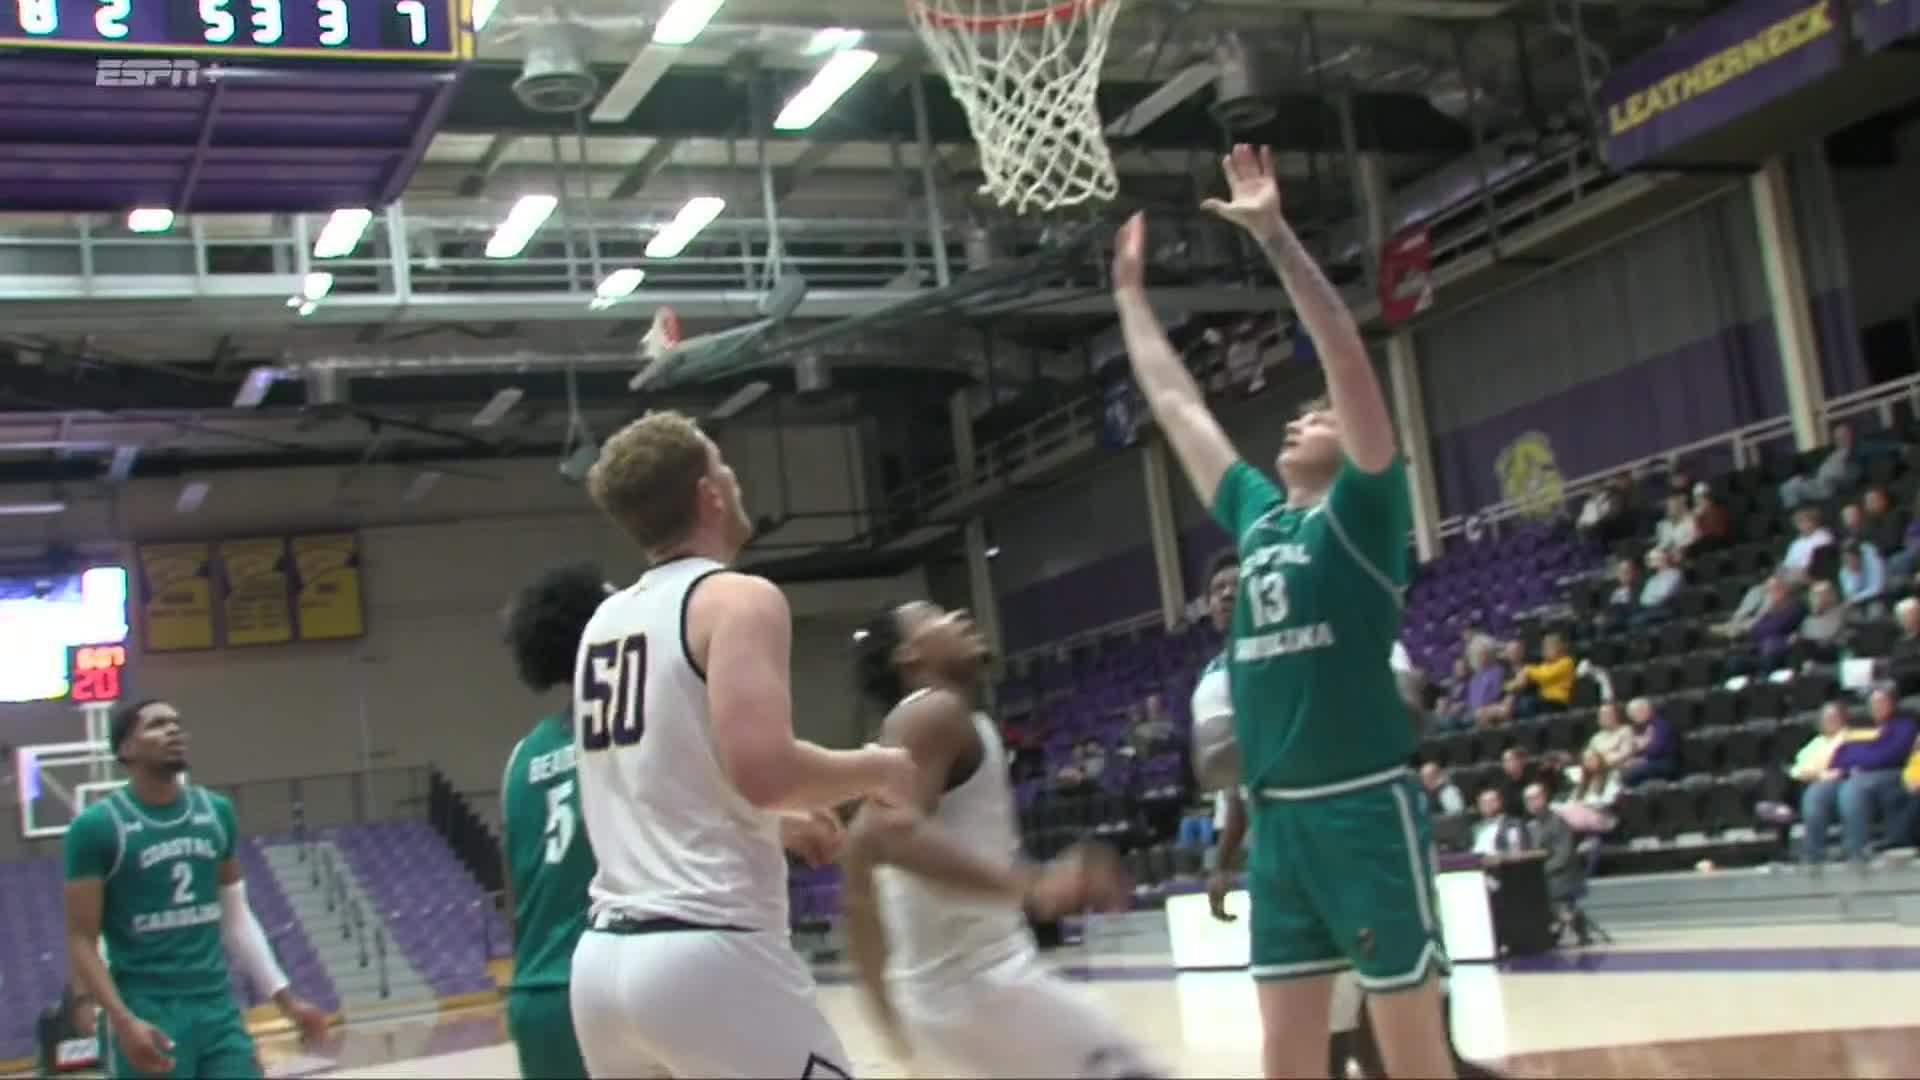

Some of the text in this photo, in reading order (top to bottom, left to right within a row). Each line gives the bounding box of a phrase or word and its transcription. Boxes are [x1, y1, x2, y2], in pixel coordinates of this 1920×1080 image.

[95, 0, 130, 38] 2
[317, 0, 348, 45] 3
[397, 0, 427, 45] 7
[1608, 0, 1832, 136] LEATHERNECK
[1248, 571, 1288, 628] 13
[582, 632, 648, 752] 50
[544, 780, 576, 864] 5
[172, 862, 196, 904] 2
